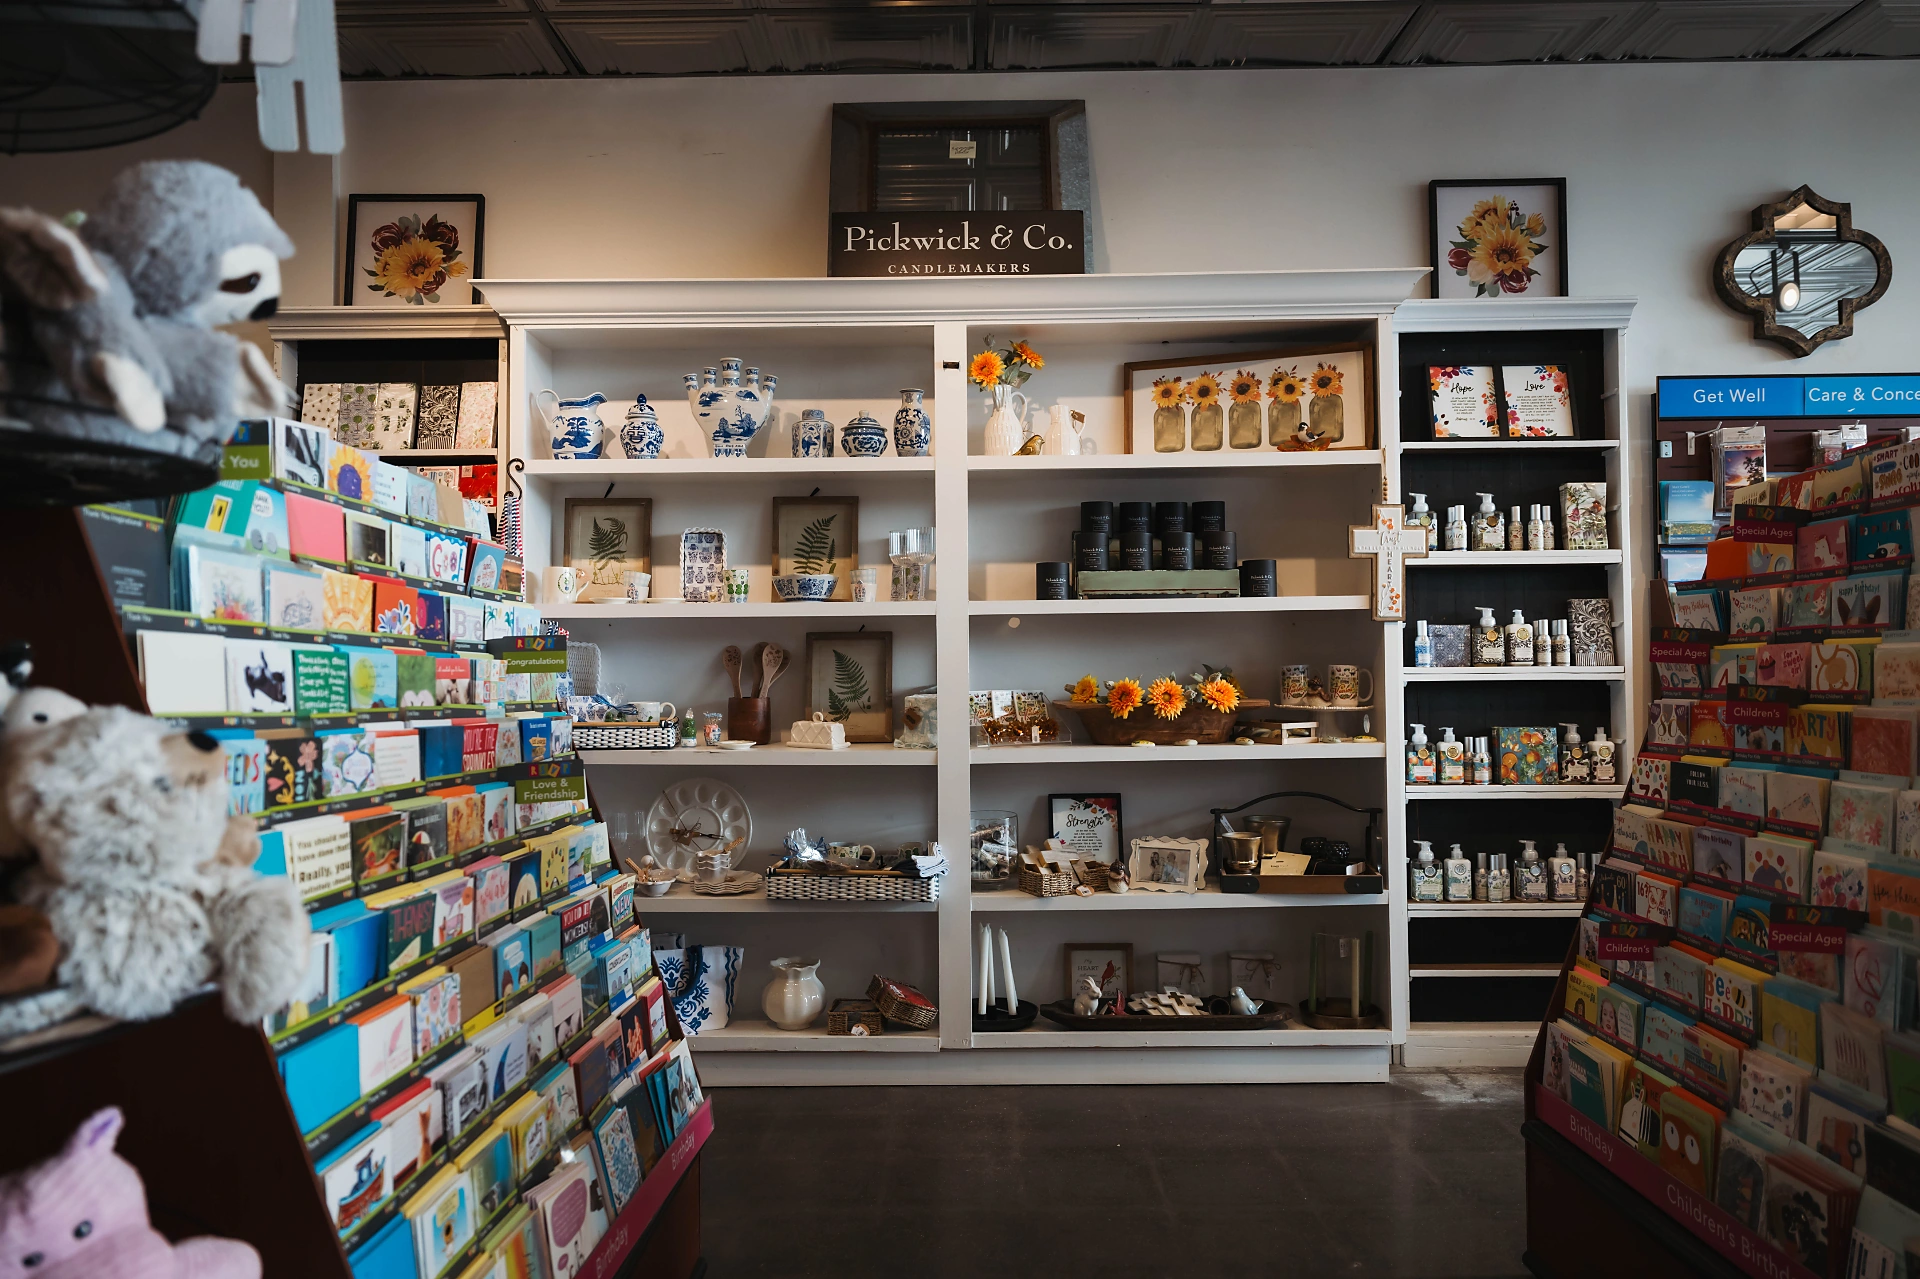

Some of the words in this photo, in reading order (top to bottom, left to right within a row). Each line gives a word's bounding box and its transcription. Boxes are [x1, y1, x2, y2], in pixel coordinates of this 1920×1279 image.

[843, 220, 981, 252] Pickwick
[990, 224, 1014, 250] &
[1023, 223, 1073, 250] Co.
[887, 263, 1031, 274] CANDLEMAKERS
[1450, 382, 1475, 395] Hope
[1524, 380, 1546, 392] Love
[1693, 389, 1724, 403] Get
[1729, 388, 1766, 402] Well
[1808, 388, 1847, 402] Care
[1853, 387, 1865, 401] &
[229, 455, 260, 468] You
[1736, 525, 1768, 537] Special
[1770, 527, 1794, 539] Ages
[1839, 586, 1853, 597] Happy
[1854, 584, 1880, 593] Birthday!
[1652, 647, 1682, 659] Special
[1684, 648, 1707, 659] Ages
[507, 657, 565, 667] Congratulations
[1733, 707, 1780, 718] Children's
[1789, 712, 1836, 742] PARTY
[532, 780, 557, 789] Love
[560, 778, 568, 787] &
[524, 789, 578, 800] Friendship
[1066, 813, 1105, 829] Strength
[1646, 823, 1683, 850] HAPPY
[1771, 930, 1812, 944] Special
[1814, 932, 1843, 947] Ages
[1605, 943, 1650, 953] Children's
[1570, 1114, 1614, 1162] Birthday
[671, 1131, 695, 1171] Birthday
[1666, 1183, 1736, 1249] Children's
[1741, 1235, 1798, 1279] Birthd
[595, 1223, 629, 1279] Birthday
